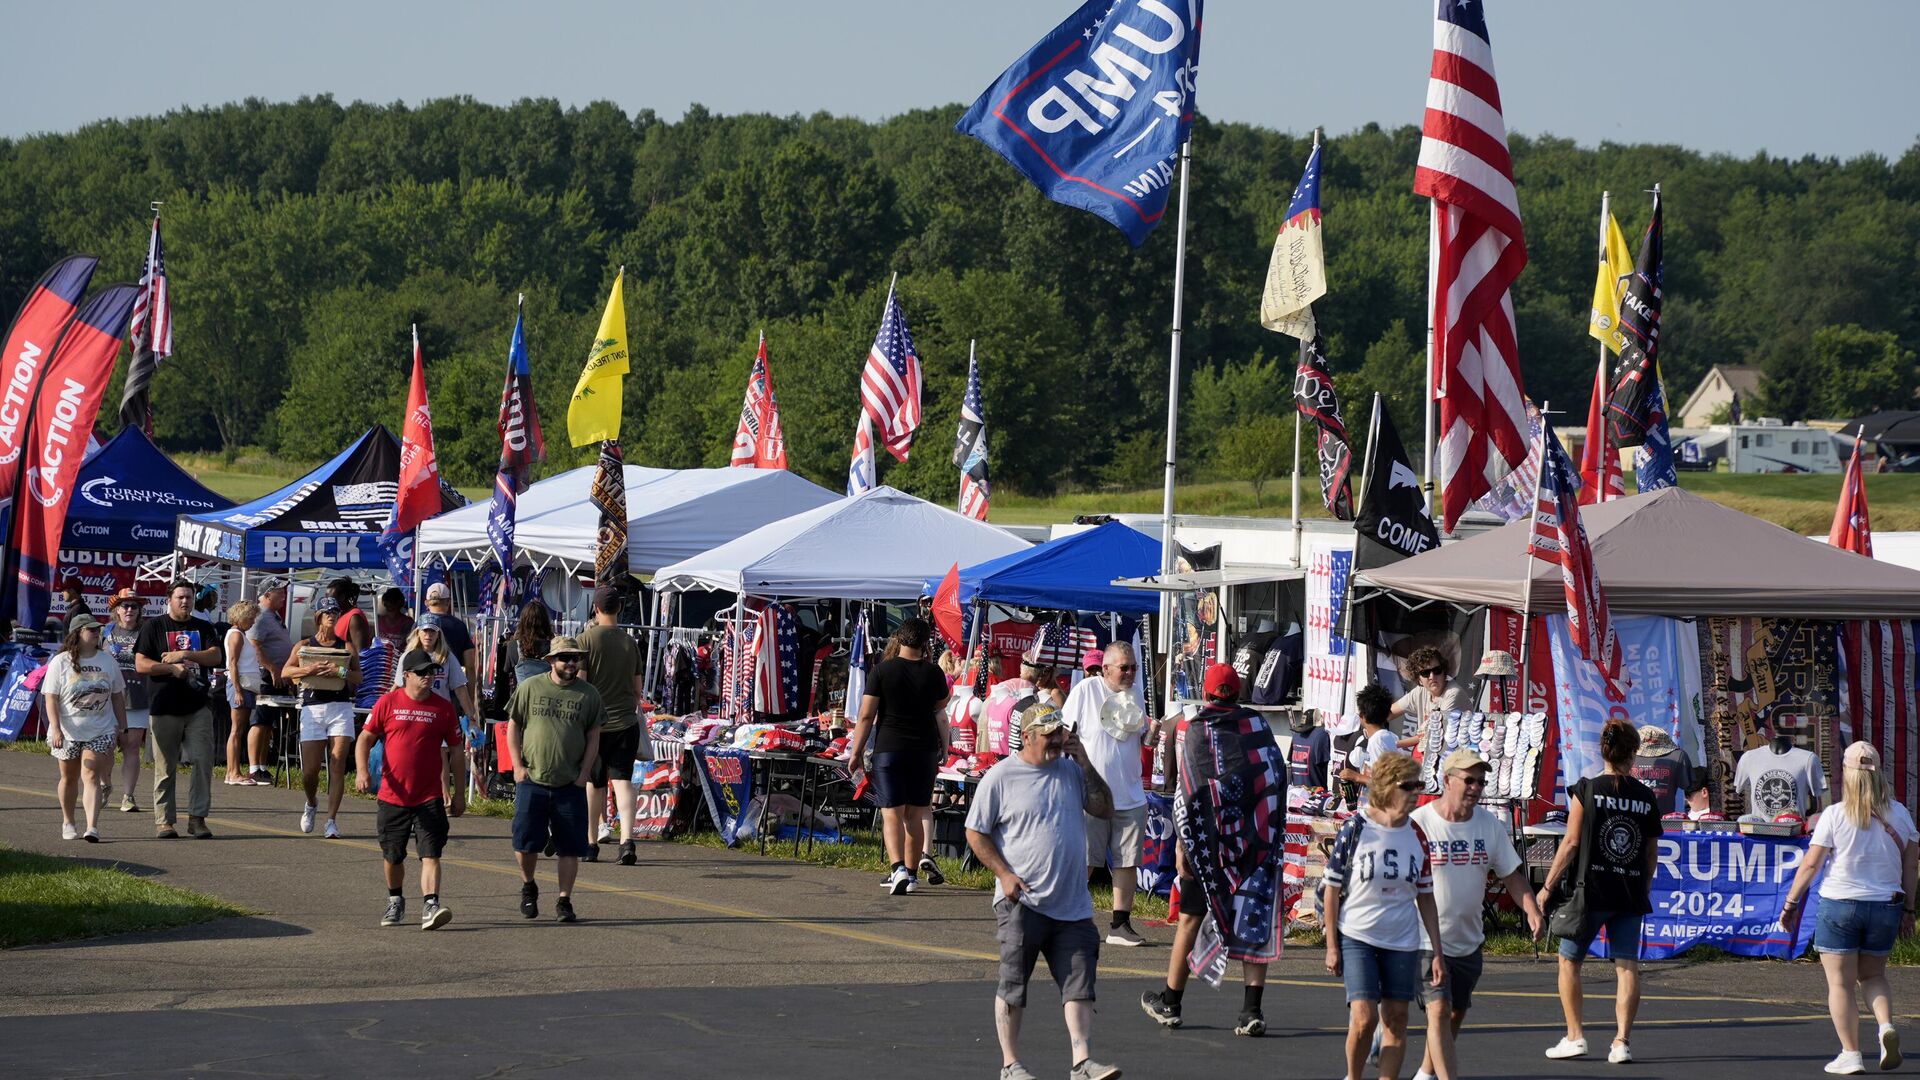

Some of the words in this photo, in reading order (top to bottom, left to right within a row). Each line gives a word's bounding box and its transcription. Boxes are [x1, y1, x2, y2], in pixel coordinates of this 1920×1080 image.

[1624, 290, 1651, 321] TAKE
[0, 340, 42, 447] ACTION
[41, 377, 86, 489] ACTION
[102, 487, 175, 499] TURNING
[104, 493, 150, 503] POINT
[157, 497, 214, 508] ACTION
[79, 525, 110, 535] ACTION
[138, 528, 168, 538] ACTION
[300, 520, 368, 530] BACK
[177, 519, 204, 552] BACK
[1377, 516, 1430, 555] COME
[263, 535, 361, 563] BACK
[997, 636, 1032, 651] TRUM
[1507, 617, 1519, 655] MAKE
[1750, 656, 1769, 694] Law
[567, 699, 582, 710] GO
[412, 710, 436, 718] AMERICA
[532, 707, 580, 721] BRANDON
[1630, 766, 1671, 780] RUMP
[635, 793, 672, 820] 202
[1593, 794, 1652, 815] TRUMP
[1428, 838, 1489, 866] USA
[1659, 923, 1734, 938] AMERICA
